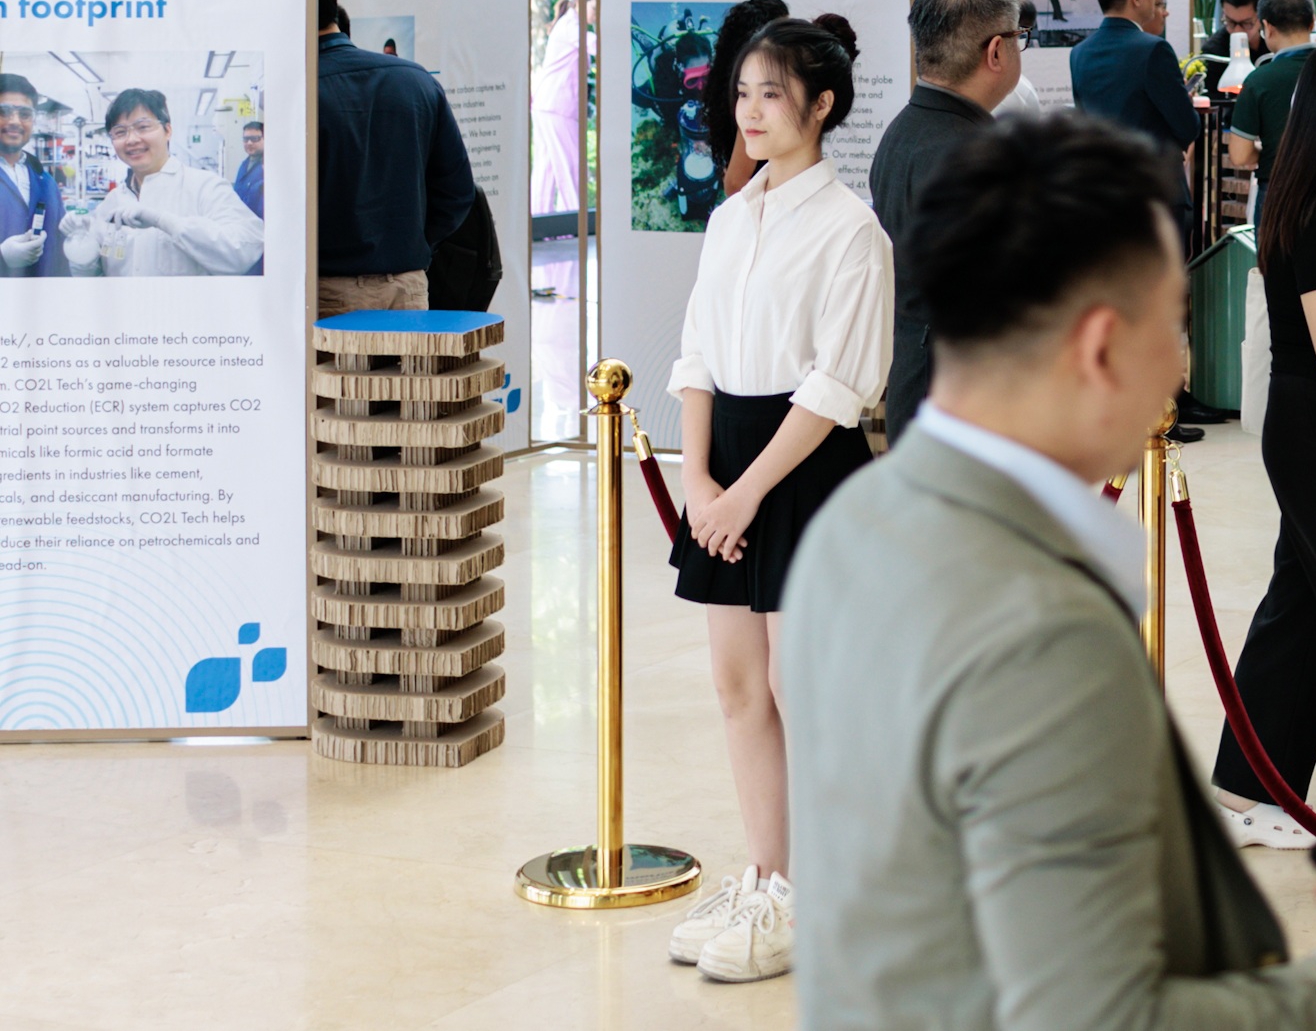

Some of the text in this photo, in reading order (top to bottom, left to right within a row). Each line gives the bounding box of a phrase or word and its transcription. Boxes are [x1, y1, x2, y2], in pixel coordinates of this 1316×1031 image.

[858, 74, 893, 87] the globe
[868, 90, 884, 100] and
[851, 120, 884, 130] health of
[832, 150, 847, 160] Our
[36, 338, 44, 346] a
[48, 333, 110, 346] Canadian
[114, 332, 159, 346] climate
[163, 332, 188, 345] tech
[192, 335, 253, 347] company,
[13, 358, 72, 368] emissions
[75, 359, 89, 368] as
[93, 359, 101, 368] a
[105, 355, 159, 368] valuable
[163, 358, 216, 367] resource
[219, 354, 264, 367] instead
[15, 378, 53, 391] CO2L
[97, 377, 197, 393] game-changing
[25, 400, 85, 413] Reduction
[90, 400, 125, 415] (ECR)
[129, 402, 169, 415] system
[174, 402, 226, 415] captures
[230, 399, 261, 411] CO2
[27, 425, 58, 439] point
[62, 426, 108, 435] sources
[112, 422, 136, 435] and
[140, 421, 203, 434] transforms
[207, 423, 214, 434] it
[218, 423, 240, 434] into
[40, 445, 60, 458] like
[64, 444, 103, 458] formic
[107, 444, 134, 457] acid
[138, 444, 162, 457] and
[166, 444, 213, 457] formate
[55, 469, 65, 480] in
[70, 468, 127, 480] industries
[130, 467, 151, 479] like
[155, 469, 203, 481] cement,
[31, 490, 55, 503] and
[59, 490, 117, 503] desiccant
[122, 489, 213, 504] manufacturing.
[218, 489, 234, 504] By
[0, 511, 246, 526] enewable feedstocks, CO2L Tech helps
[35, 535, 61, 547] their
[66, 535, 115, 547] reliance
[119, 539, 134, 547] on
[139, 533, 232, 550] petrochemicals
[236, 533, 260, 546] and
